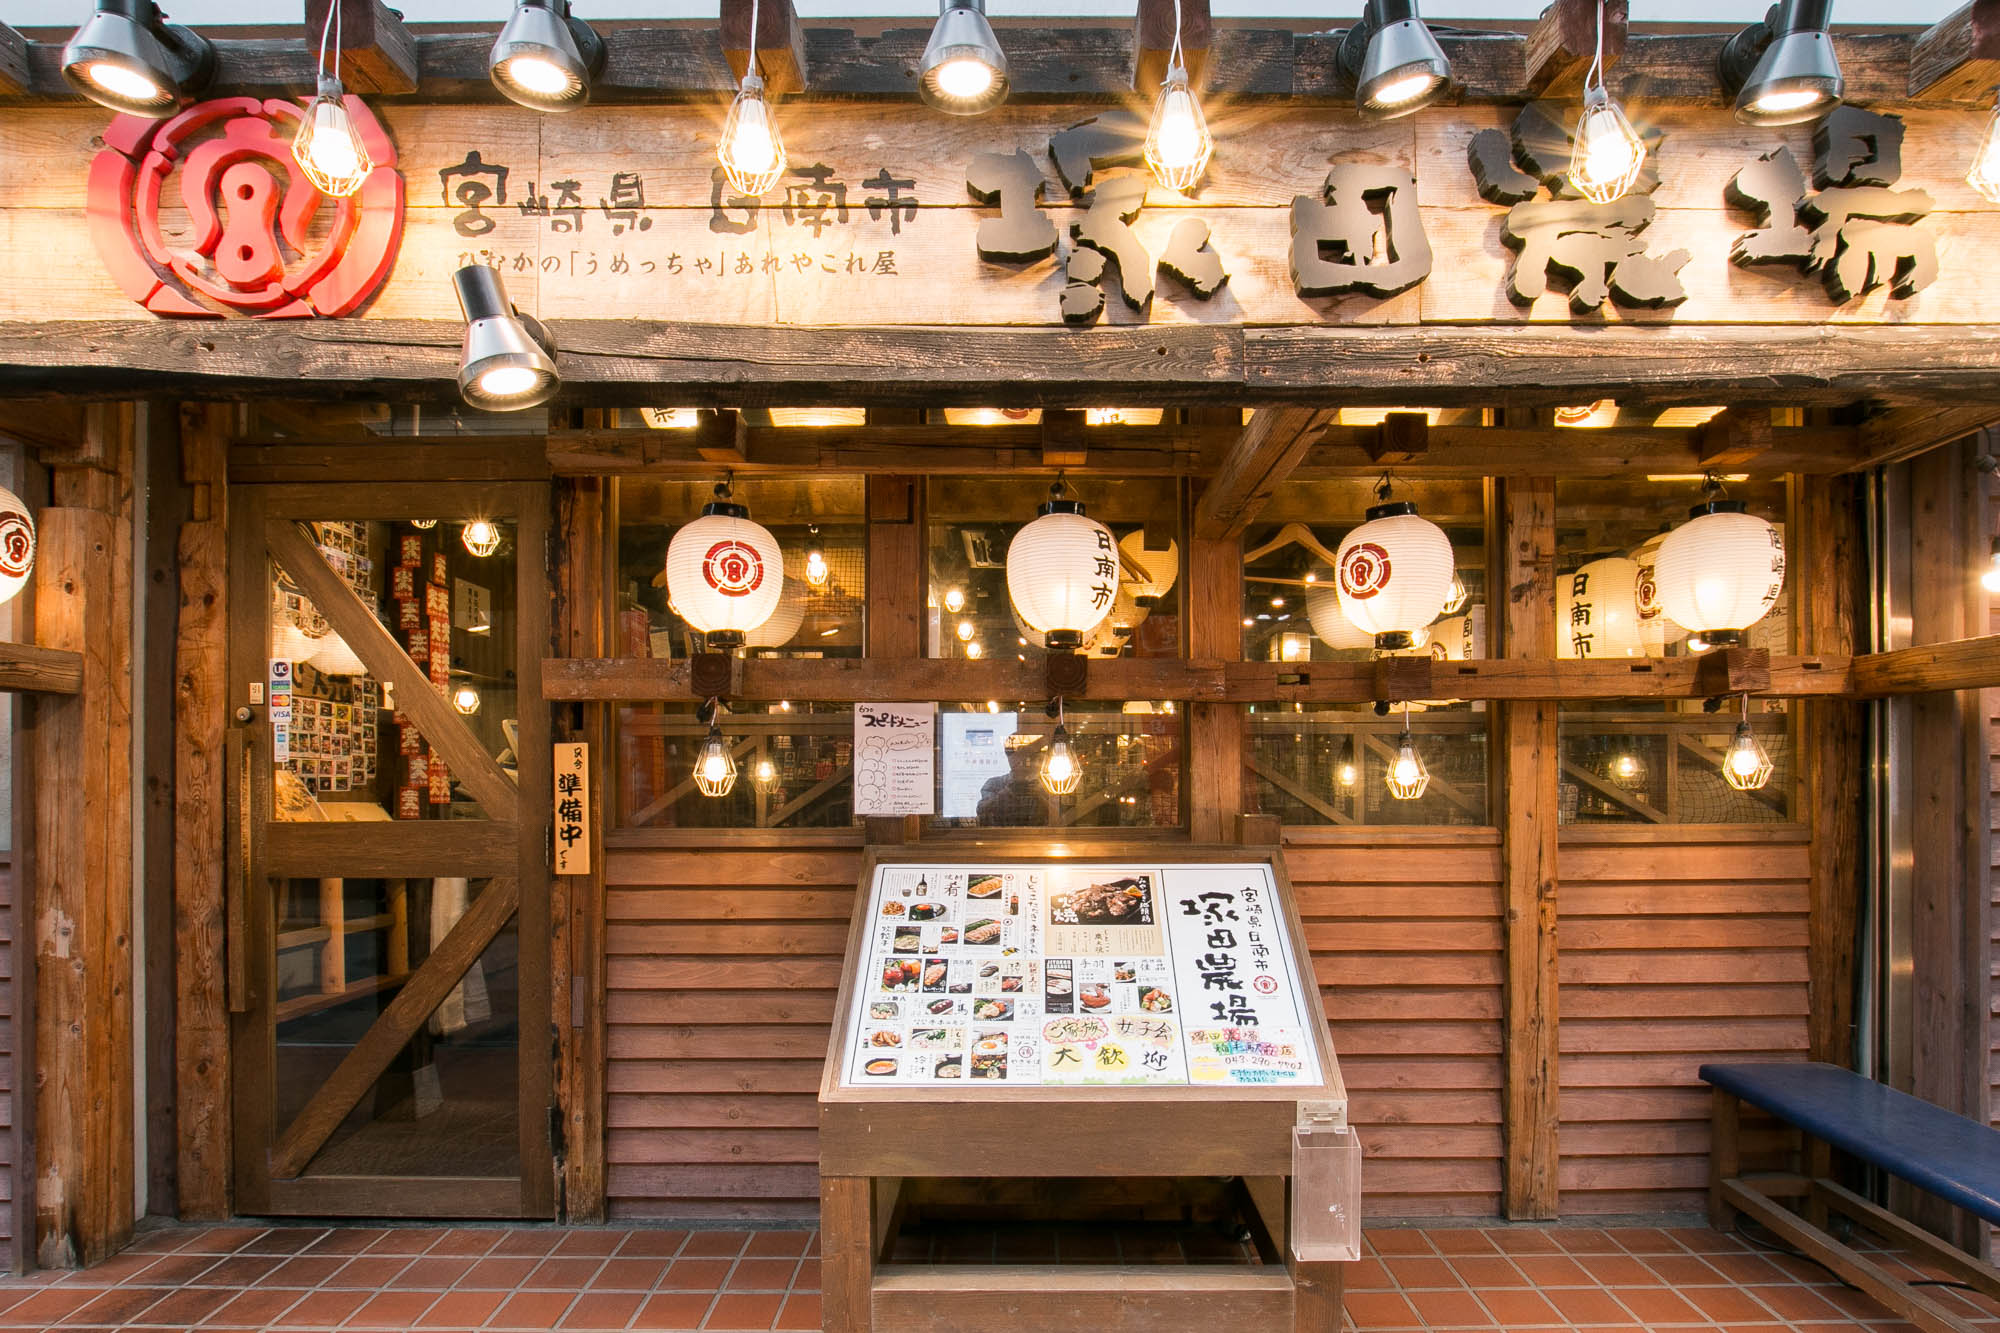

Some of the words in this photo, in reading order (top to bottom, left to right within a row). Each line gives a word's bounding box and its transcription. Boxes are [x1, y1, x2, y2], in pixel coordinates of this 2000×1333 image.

[438, 150, 653, 237] 宮崎県
[709, 162, 919, 239] 日南市
[1090, 529, 1116, 610] 日南市
[1571, 572, 1595, 658] 日南市
[862, 712, 929, 729] スピードメニュー
[558, 773, 583, 848] 準備中
[1179, 891, 1259, 1026] 塚田農場
[1240, 886, 1270, 972] 宮崎県日南市
[1050, 1021, 1104, 1039] ご家族
[1052, 1046, 1168, 1072] 大歓迎
[1117, 1018, 1172, 1040] 女子会
